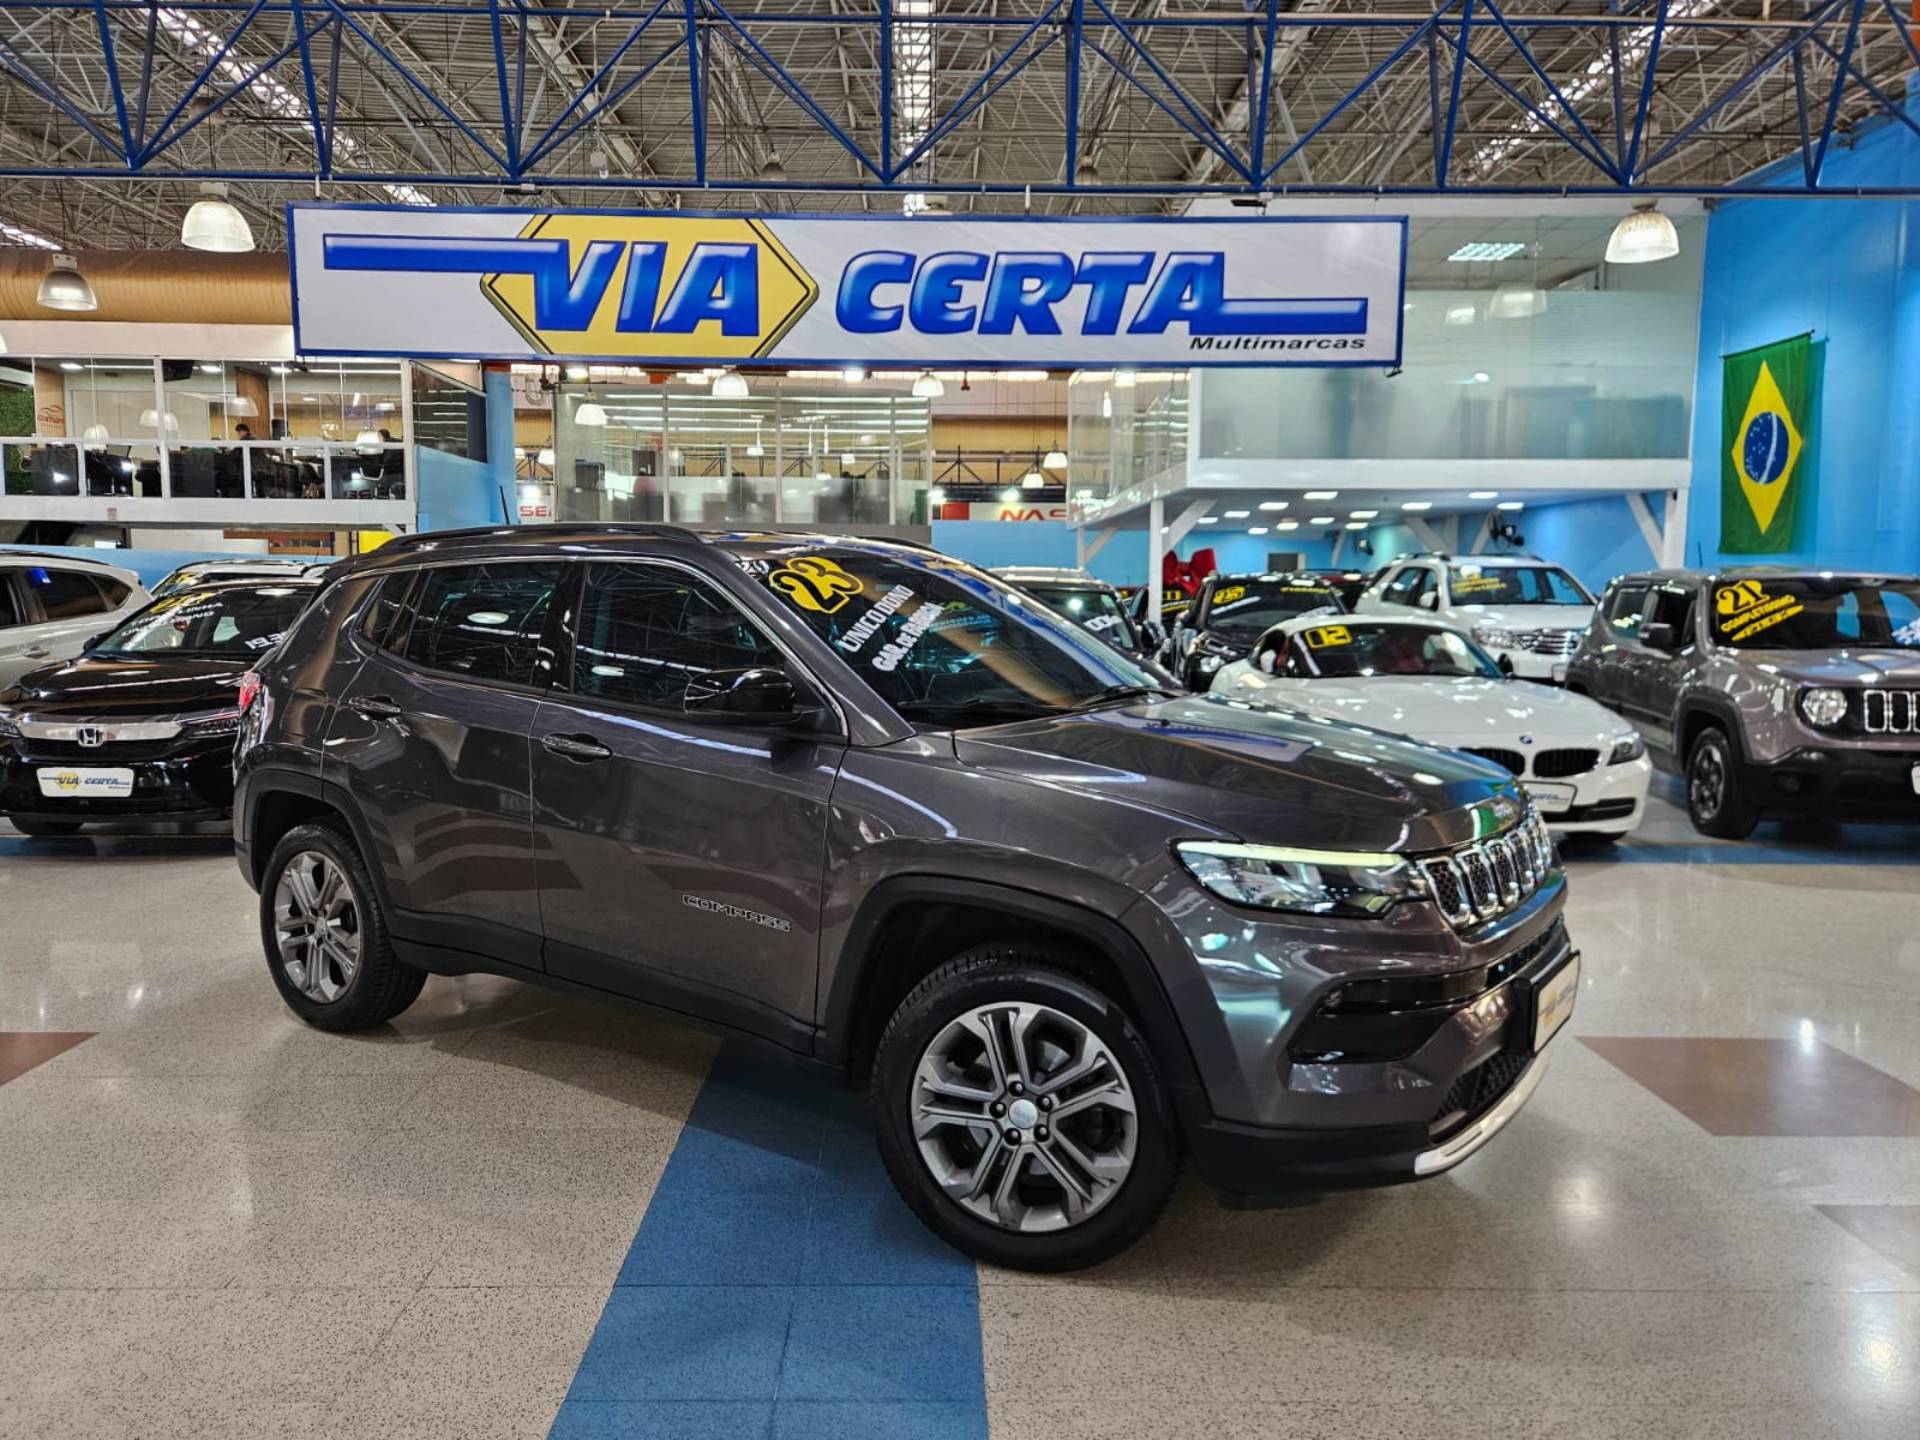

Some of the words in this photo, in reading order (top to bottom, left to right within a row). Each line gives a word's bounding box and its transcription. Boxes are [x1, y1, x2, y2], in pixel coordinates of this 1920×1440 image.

[505, 236, 760, 337] VIA
[835, 249, 1224, 336] CERTA
[1189, 335, 1366, 350] Multimarcas
[768, 556, 864, 614] 23
[1715, 579, 1771, 615] 21
[682, 894, 791, 932] COMPASS
